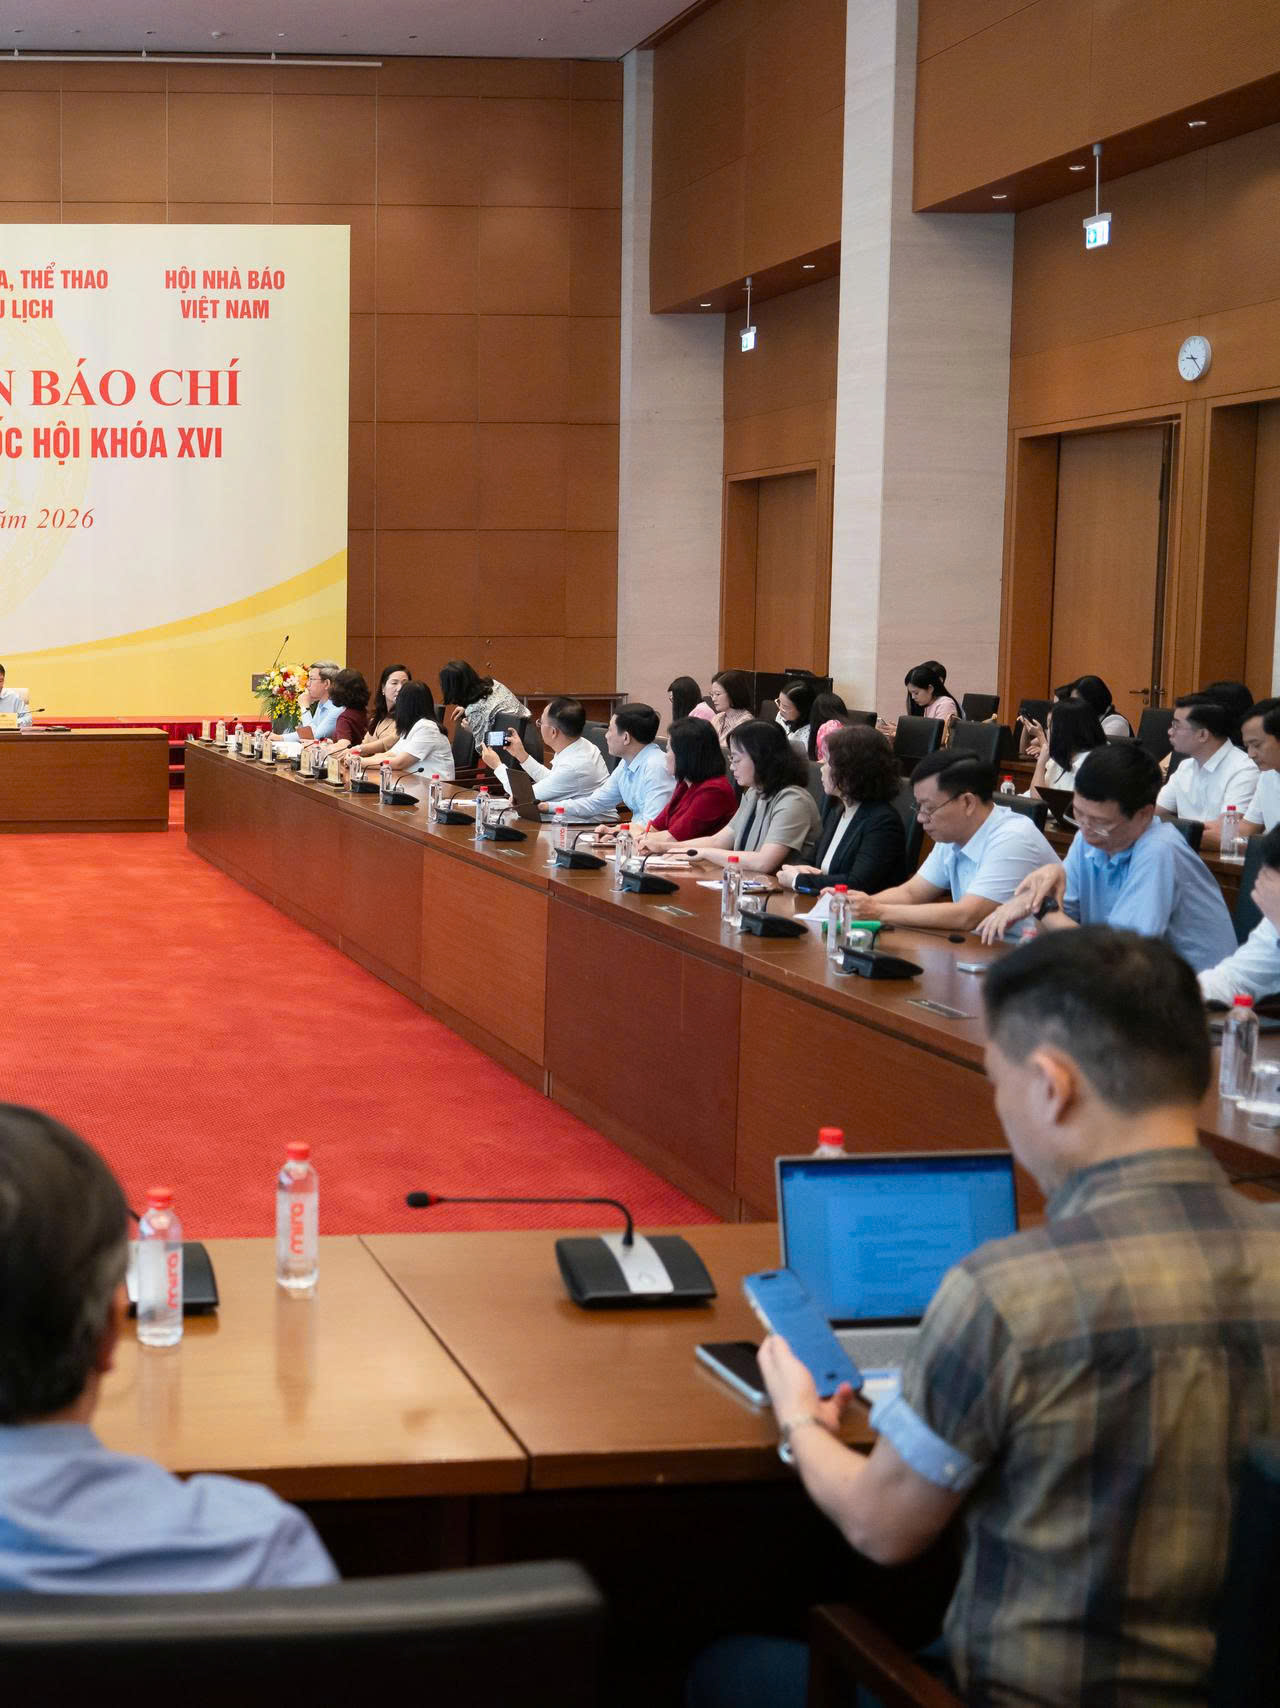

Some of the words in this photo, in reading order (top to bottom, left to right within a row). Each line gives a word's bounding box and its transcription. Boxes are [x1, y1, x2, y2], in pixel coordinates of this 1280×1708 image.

[20, 261, 57, 290] THỂ
[60, 269, 109, 290] THAO
[164, 265, 197, 293] HỘI
[202, 267, 242, 290] NHÀ
[247, 267, 286, 290] BÁO
[11, 298, 54, 324] LỊCH
[179, 295, 221, 324] VIỆT
[225, 298, 270, 320] NAM
[30, 358, 137, 407] BÁO
[149, 358, 243, 407] CHÍ
[32, 420, 81, 466] HỘI
[90, 420, 169, 459] KHÓA
[176, 426, 223, 459] XVI
[36, 508, 95, 529] 2026
[289, 1202, 305, 1255] mira
